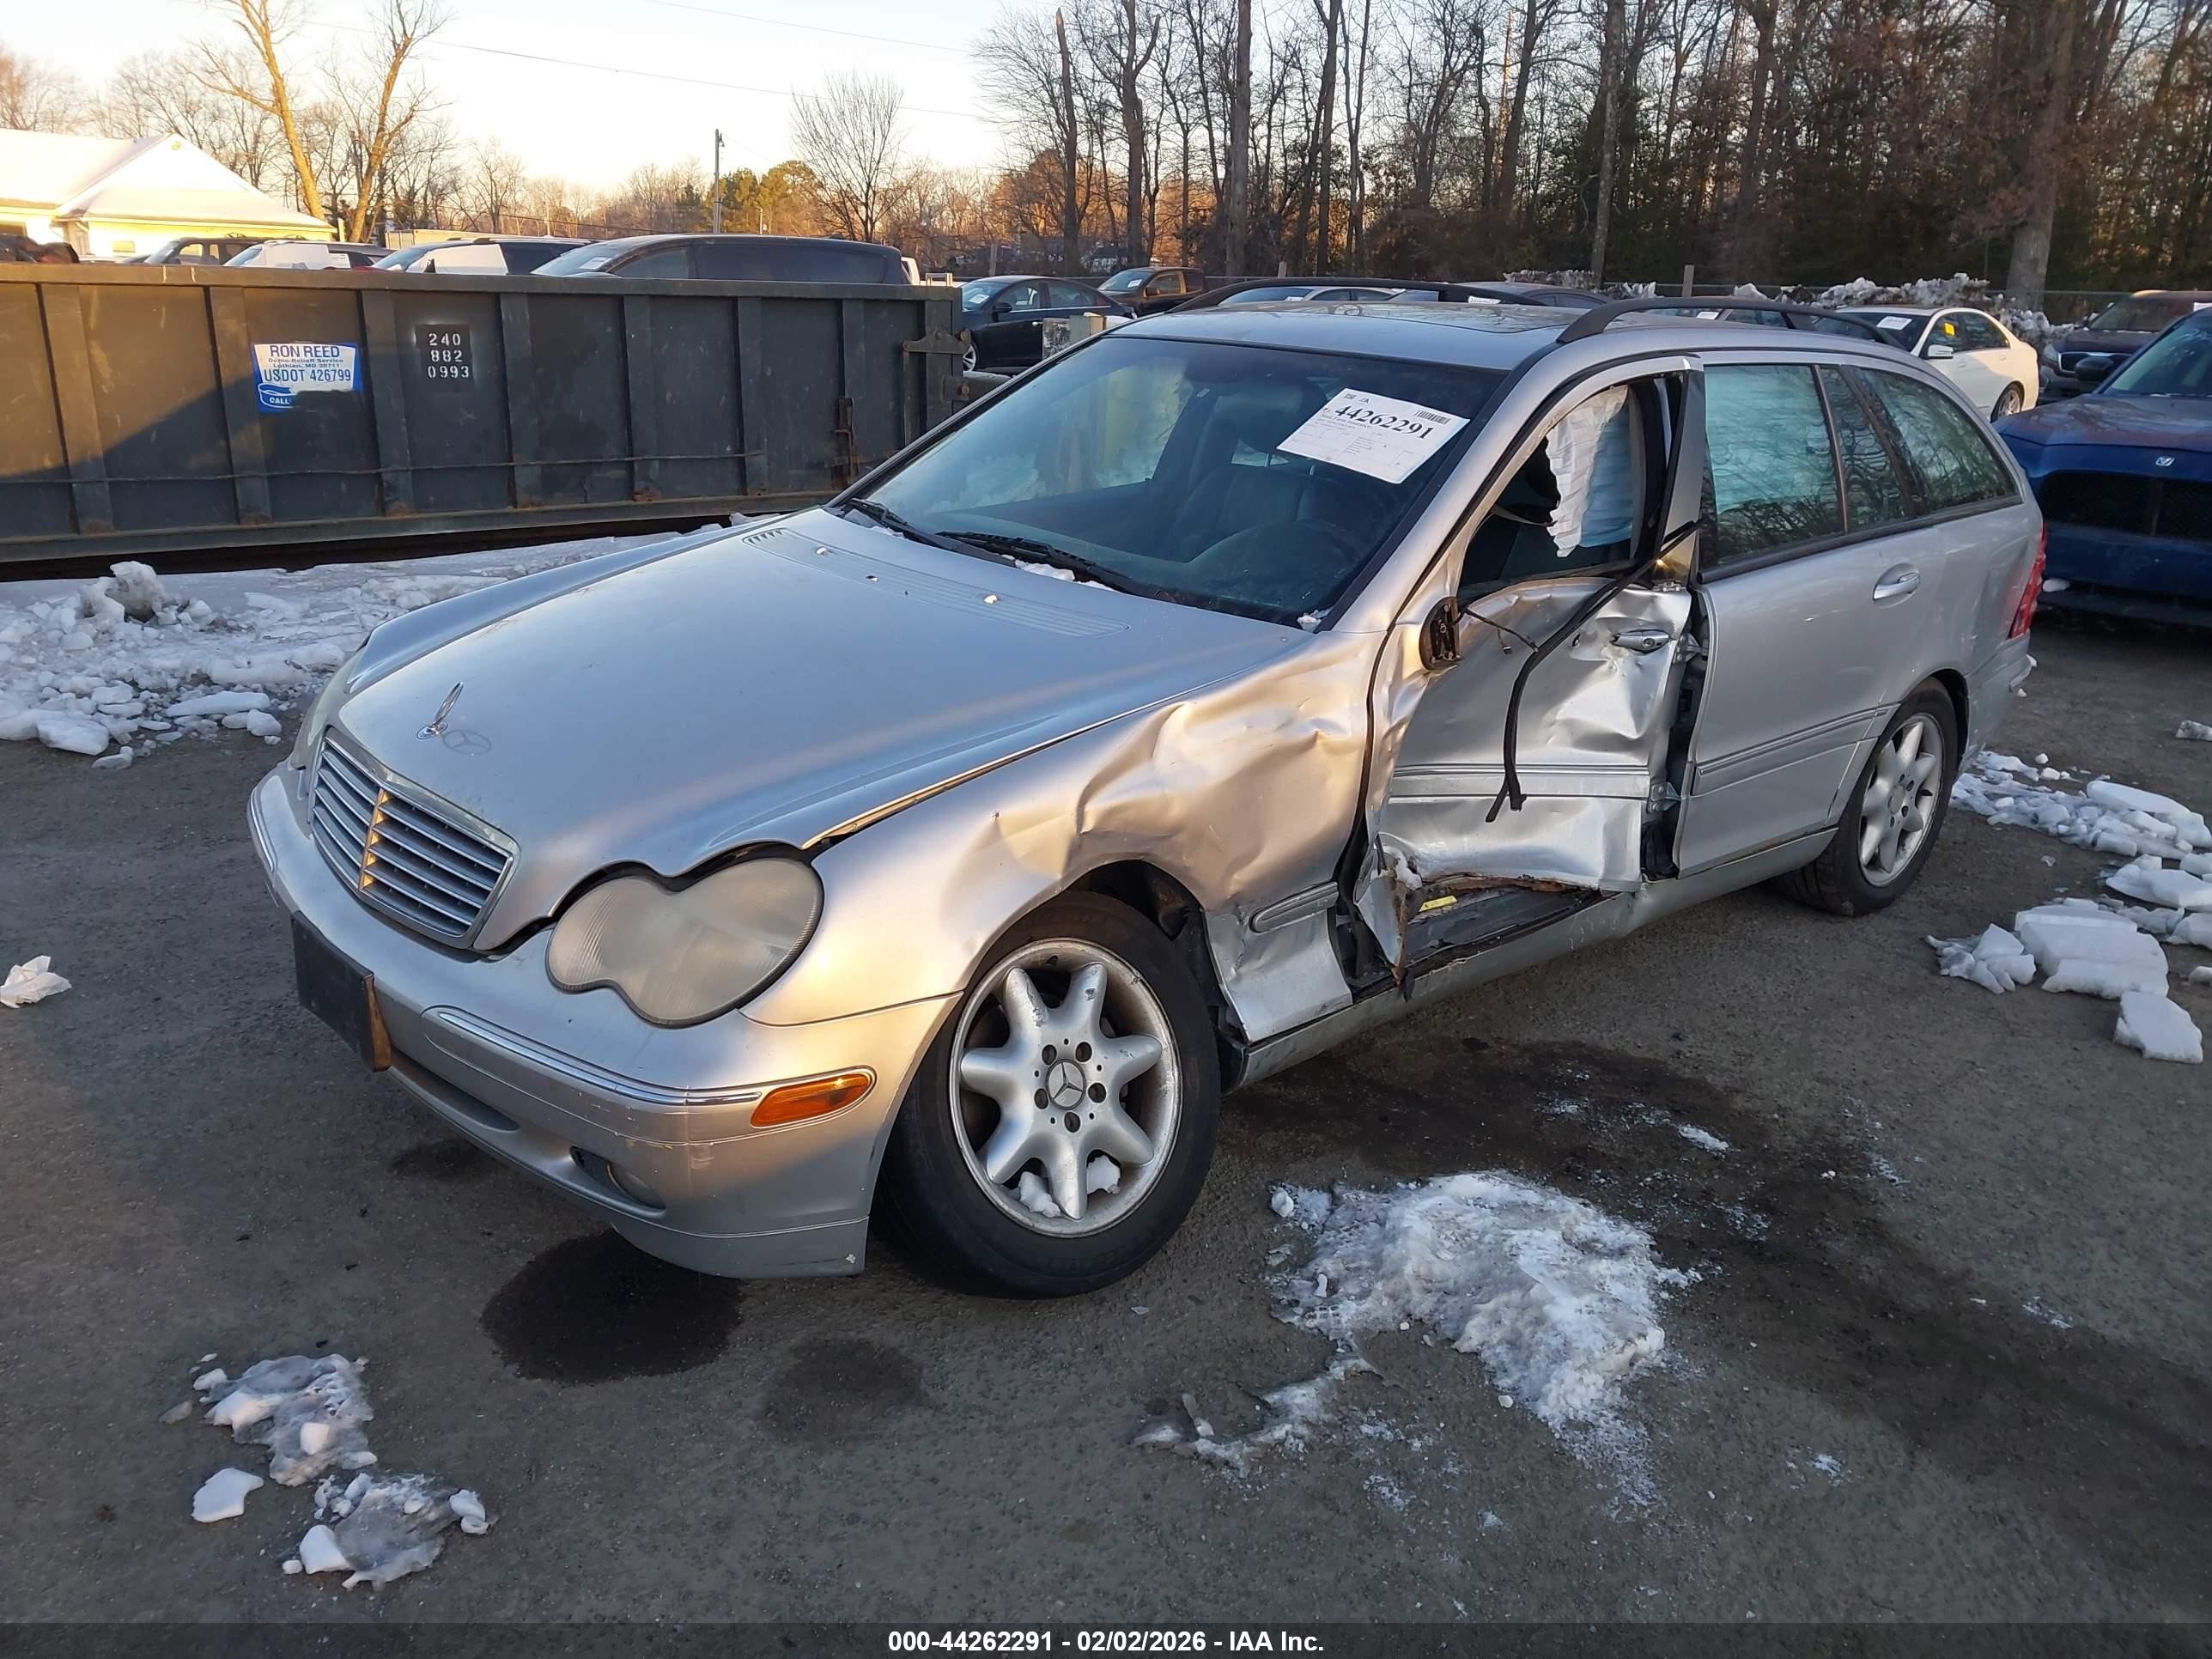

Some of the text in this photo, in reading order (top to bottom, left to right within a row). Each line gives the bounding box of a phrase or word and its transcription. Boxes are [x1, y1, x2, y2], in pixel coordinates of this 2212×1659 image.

[428, 333, 461, 346] 240
[270, 344, 340, 358] RON REED
[430, 349, 463, 362] 882
[264, 369, 351, 382] USDOT 426799
[428, 365, 470, 379] 0993
[1334, 405, 1436, 440] 44262291
